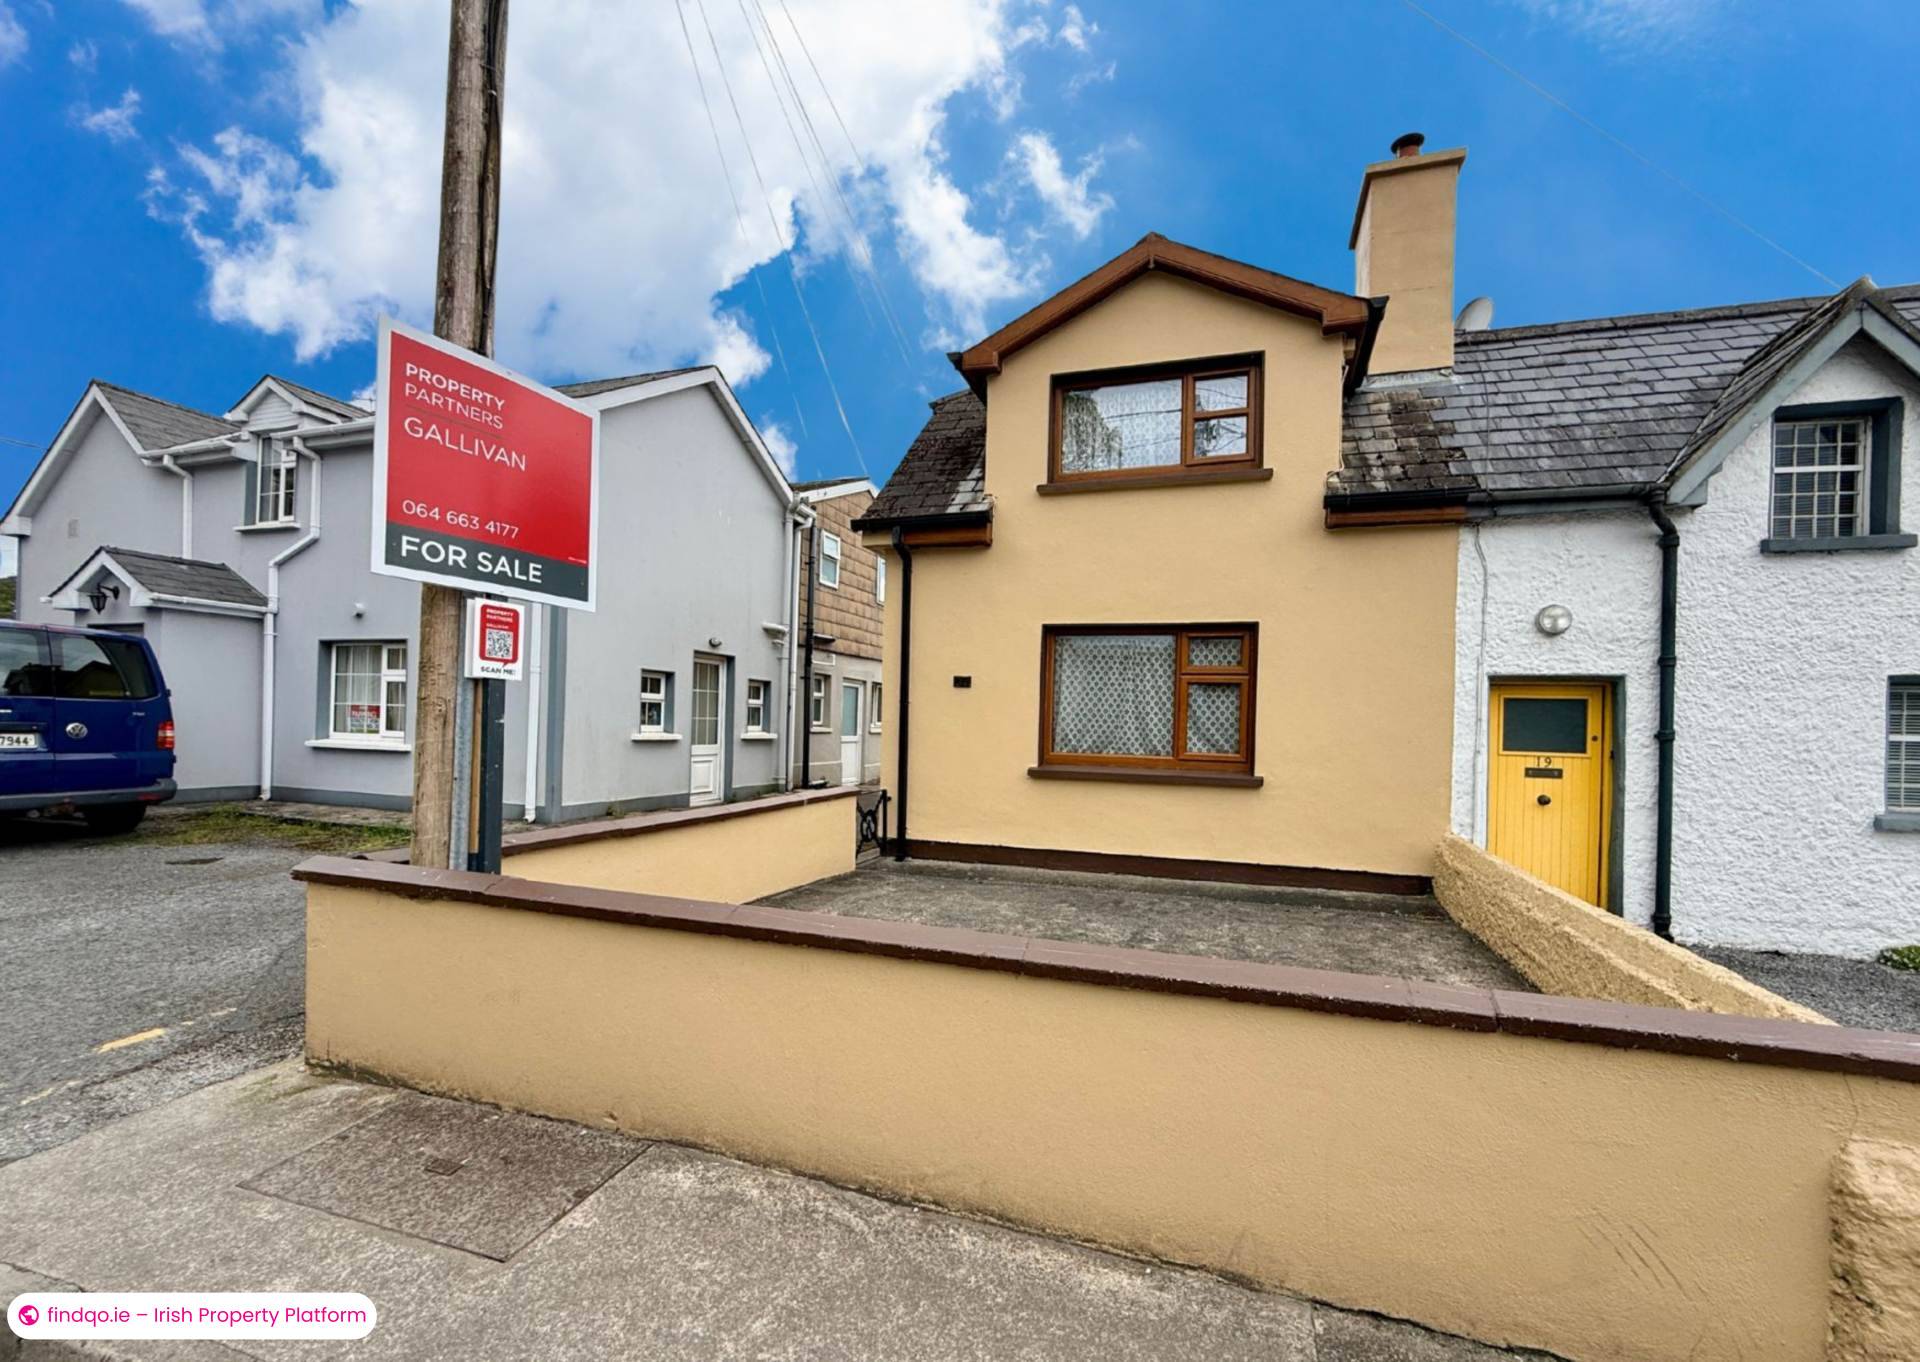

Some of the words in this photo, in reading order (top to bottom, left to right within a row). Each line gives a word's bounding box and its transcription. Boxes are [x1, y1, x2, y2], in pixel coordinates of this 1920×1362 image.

[405, 382, 504, 430] PARTNERS
[406, 362, 505, 411] PROPERTY
[404, 416, 526, 472] GALLIVAN
[402, 500, 440, 520] 064
[446, 511, 480, 530] 663
[485, 521, 519, 539] 4177
[401, 535, 467, 569] FOR
[477, 551, 542, 584] SALE
[480, 666, 501, 674] SCAN
[0, 736, 29, 746] 7944
[1537, 755, 1552, 768] 19
